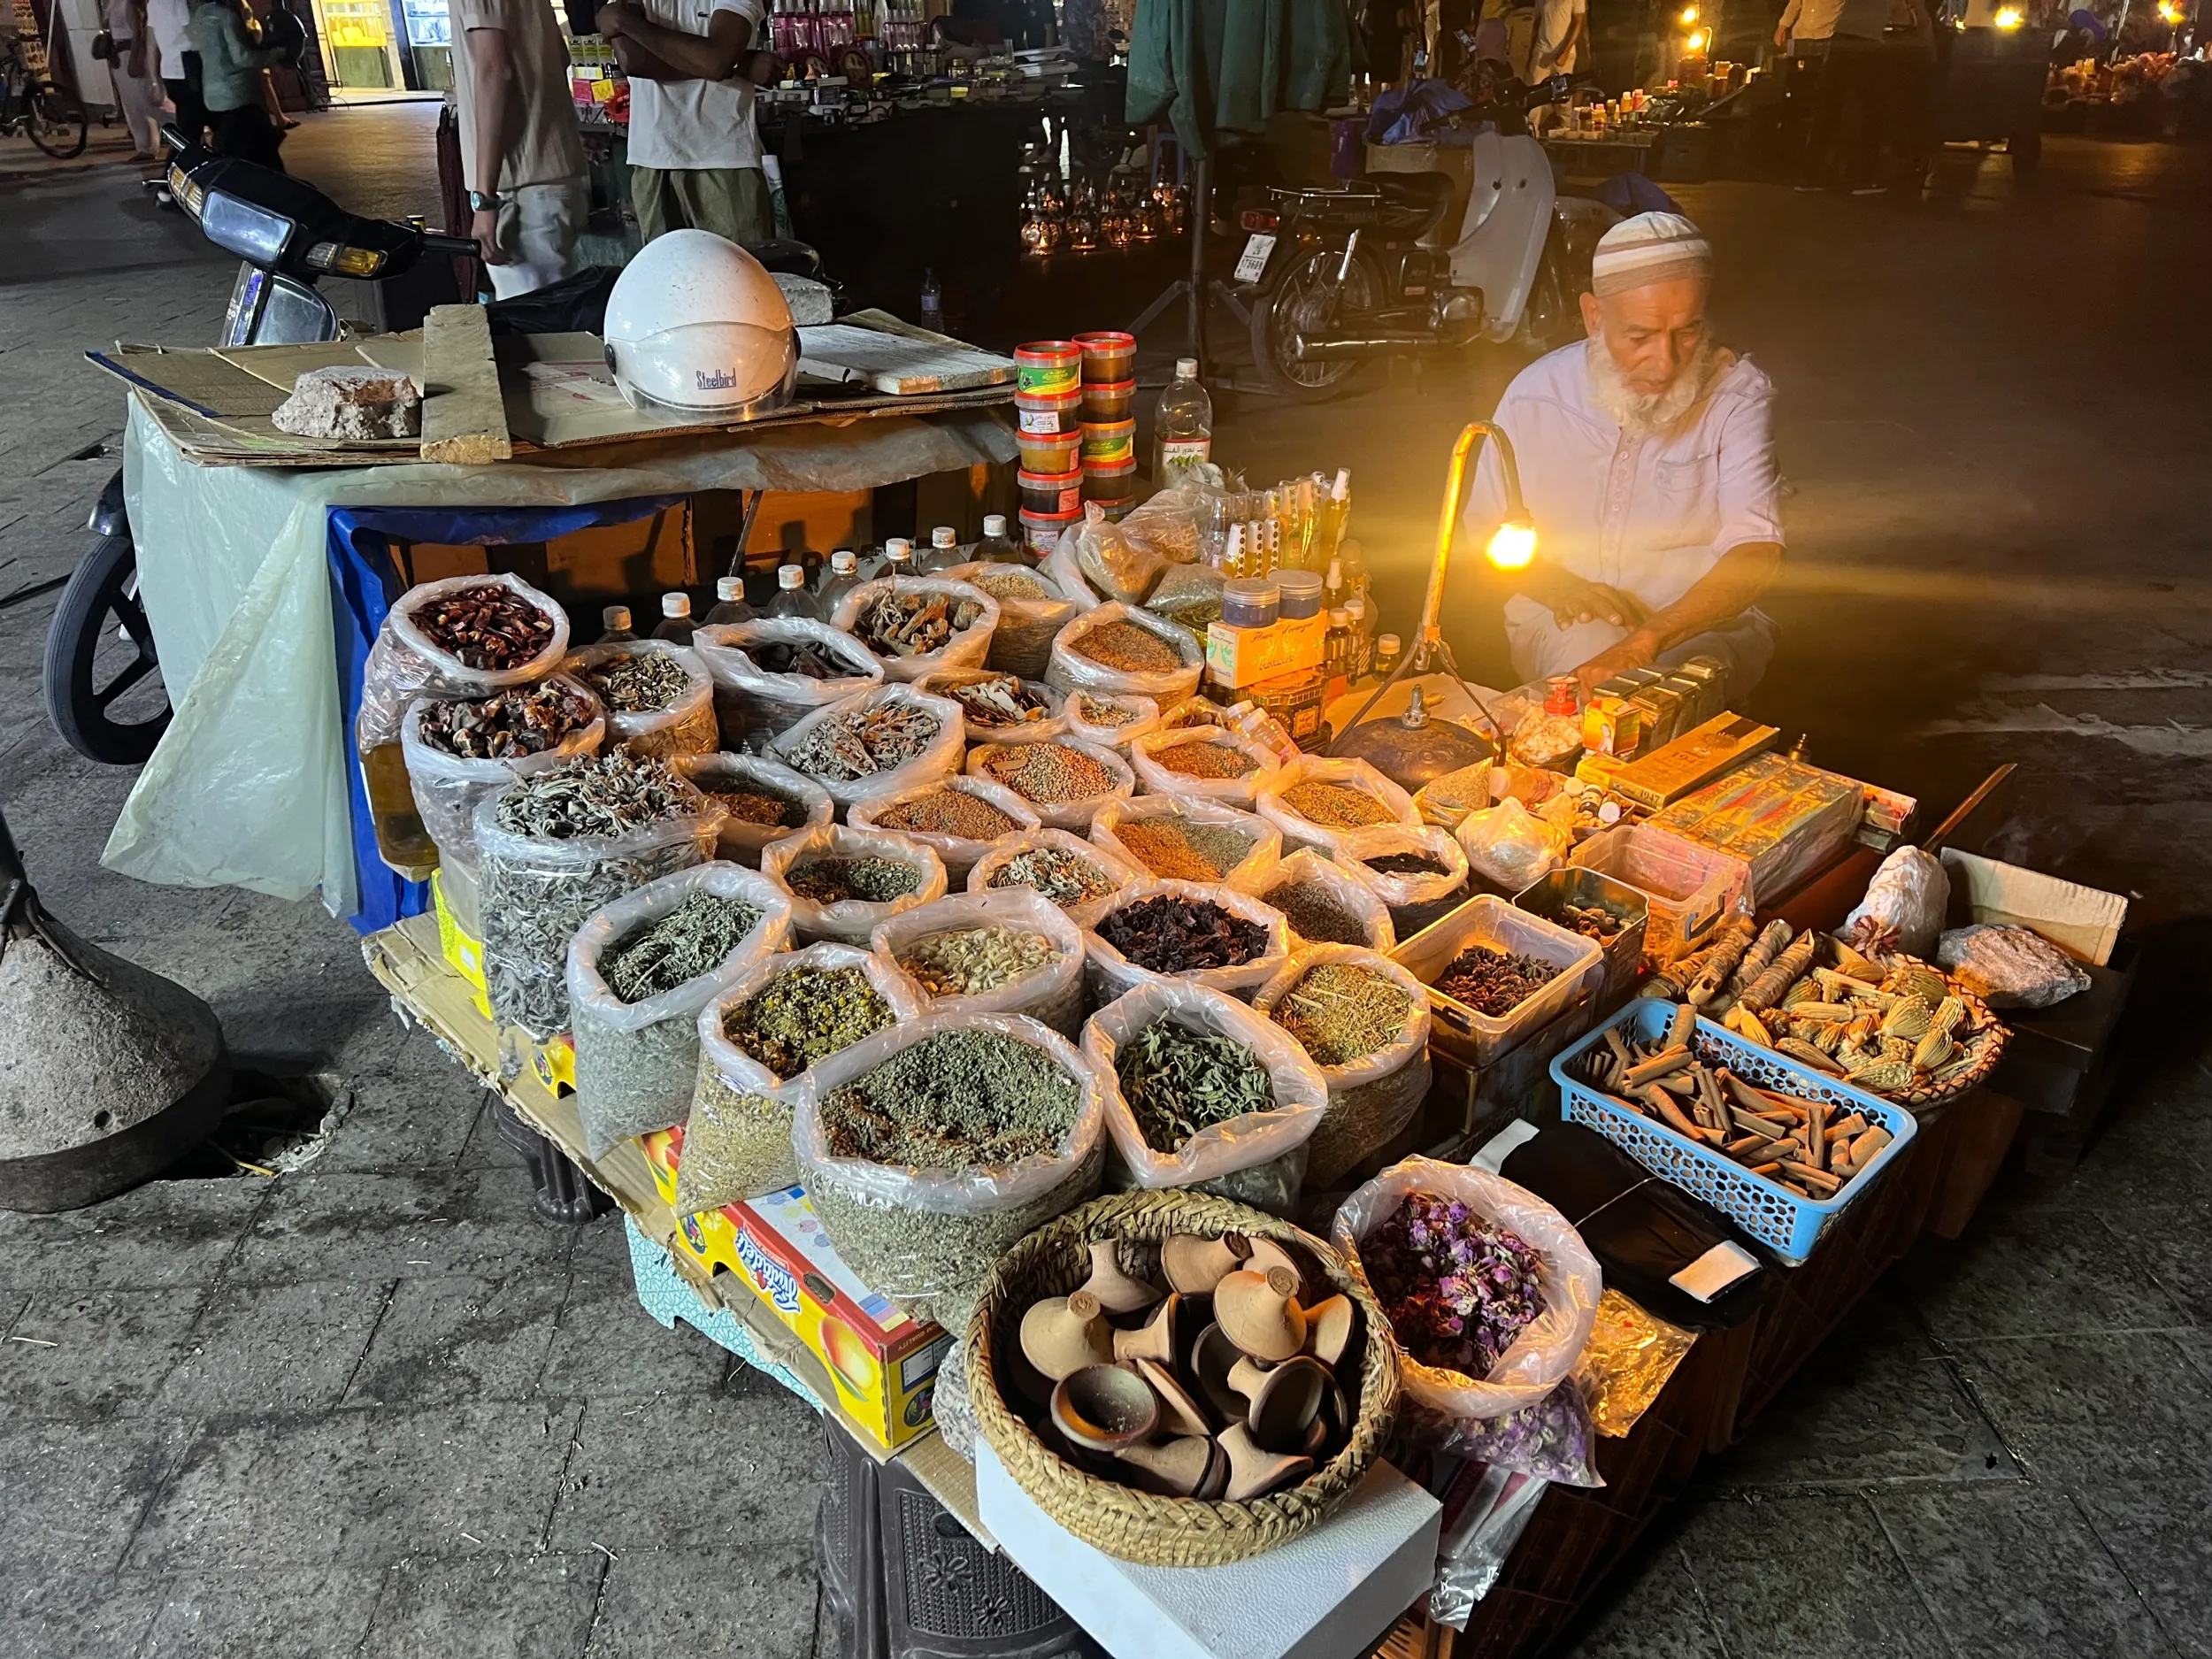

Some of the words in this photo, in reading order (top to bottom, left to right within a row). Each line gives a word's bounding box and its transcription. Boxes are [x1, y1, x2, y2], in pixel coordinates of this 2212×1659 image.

[696, 367, 736, 389] Steelbird
[1640, 789, 1661, 803] 1947
[735, 1228, 801, 1313] Frutadeli
[897, 1330, 926, 1352] QUALITY
